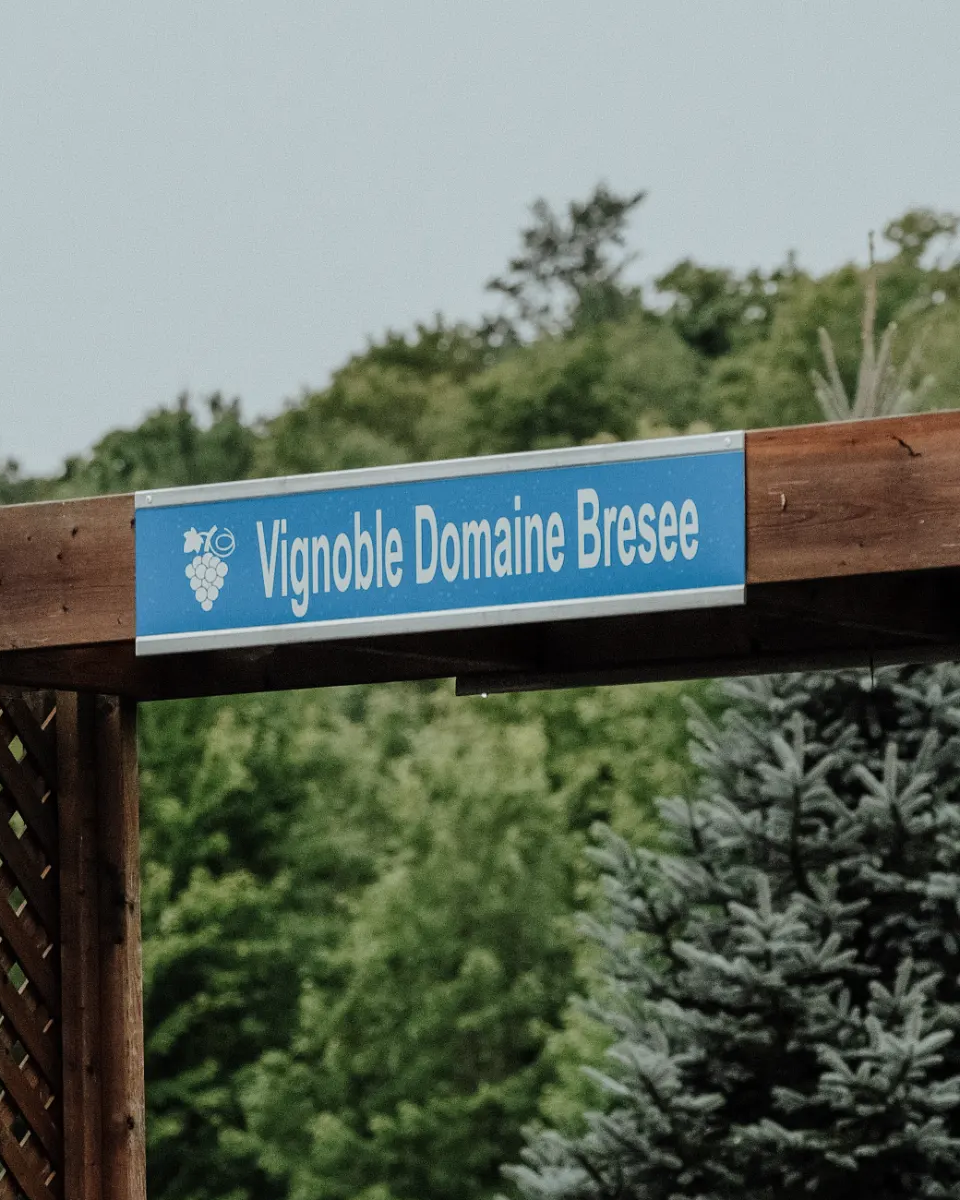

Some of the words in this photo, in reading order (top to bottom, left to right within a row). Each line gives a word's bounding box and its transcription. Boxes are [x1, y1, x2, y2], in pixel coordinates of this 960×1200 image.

[256, 509, 403, 617] Vignoble
[415, 496, 565, 584] Domaine
[577, 487, 699, 569] Bresee
